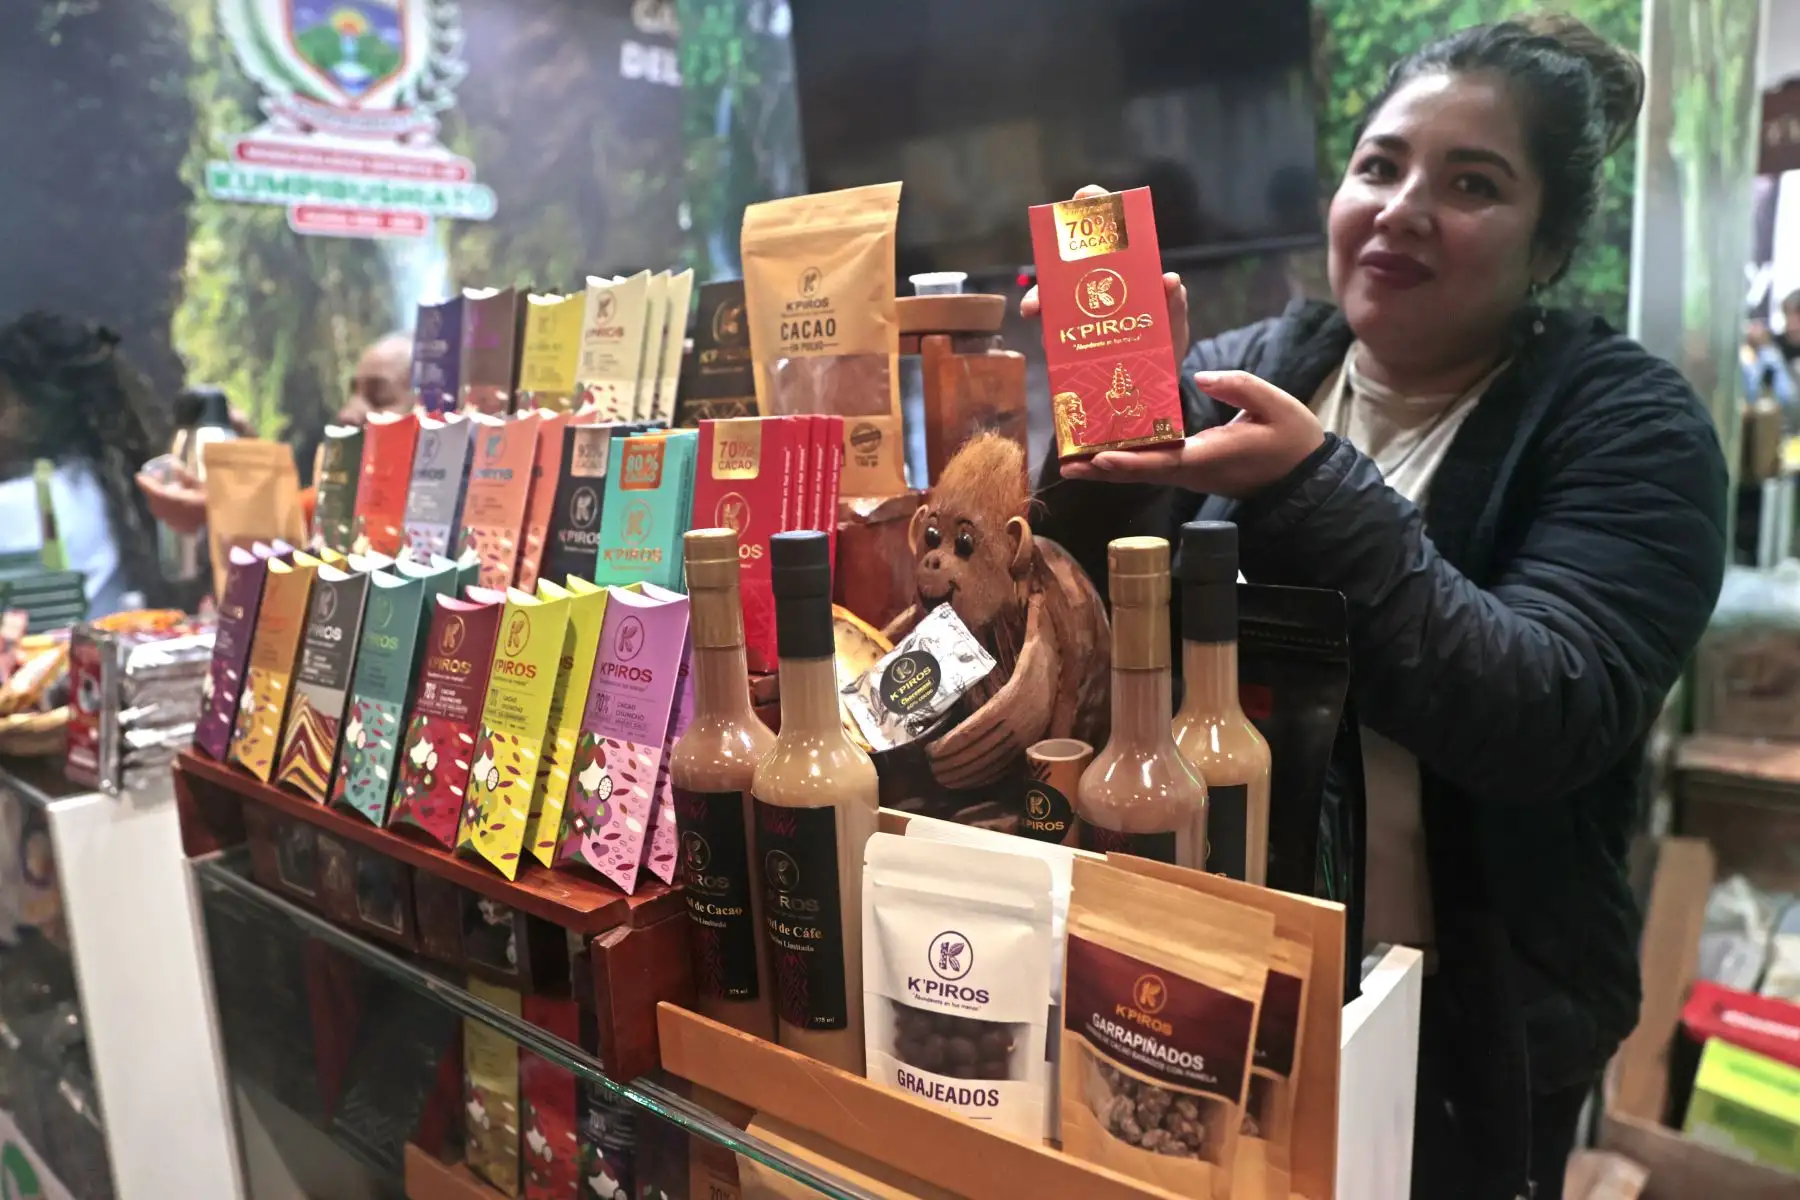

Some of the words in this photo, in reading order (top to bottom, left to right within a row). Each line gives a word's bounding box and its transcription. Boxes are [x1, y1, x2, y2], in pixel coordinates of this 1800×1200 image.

[1066, 214, 1118, 239] 70%
[1069, 232, 1119, 251] CACAO
[780, 318, 836, 341] CACAO
[719, 440, 754, 459] 70%
[718, 460, 752, 471] CACAO
[706, 903, 743, 916] Cacao
[907, 976, 990, 1004] K'PIROS
[1092, 1012, 1204, 1071] GARRAPIÑADOS
[897, 1068, 999, 1107] GRAJEADOS
